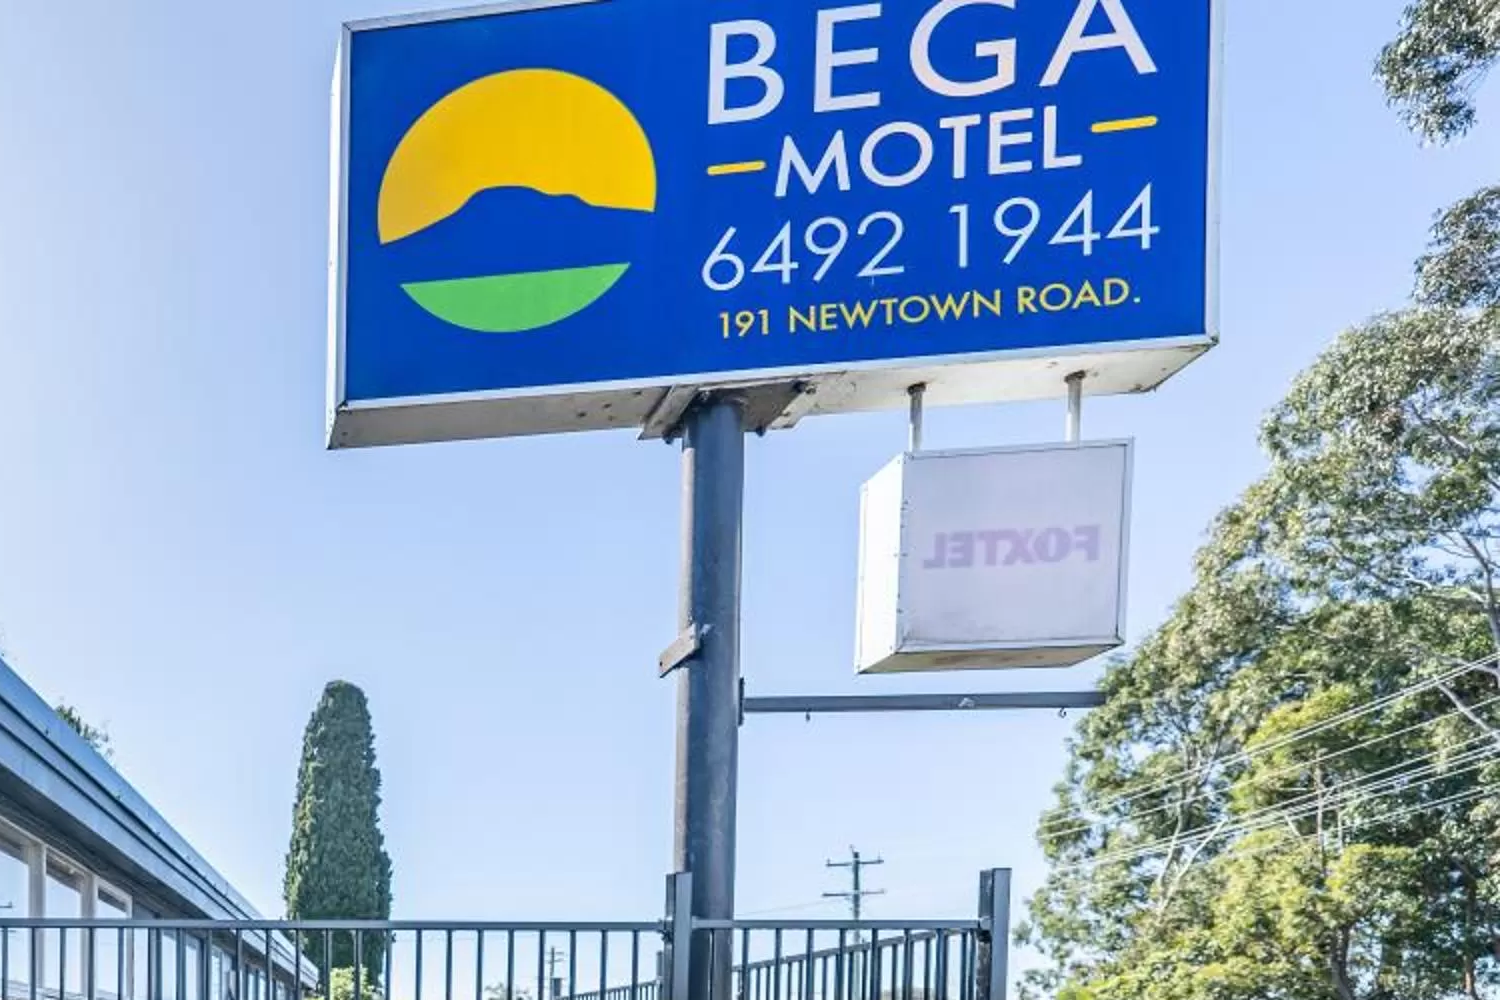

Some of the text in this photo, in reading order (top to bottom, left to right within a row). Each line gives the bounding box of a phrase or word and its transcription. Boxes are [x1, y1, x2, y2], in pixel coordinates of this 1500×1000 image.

[707, 0, 1157, 125] BEGA
[774, 105, 1082, 197] MOTEL
[701, 182, 1160, 291] 6492 1944
[719, 277, 1141, 338] 191 NEWTOWN ROAD.
